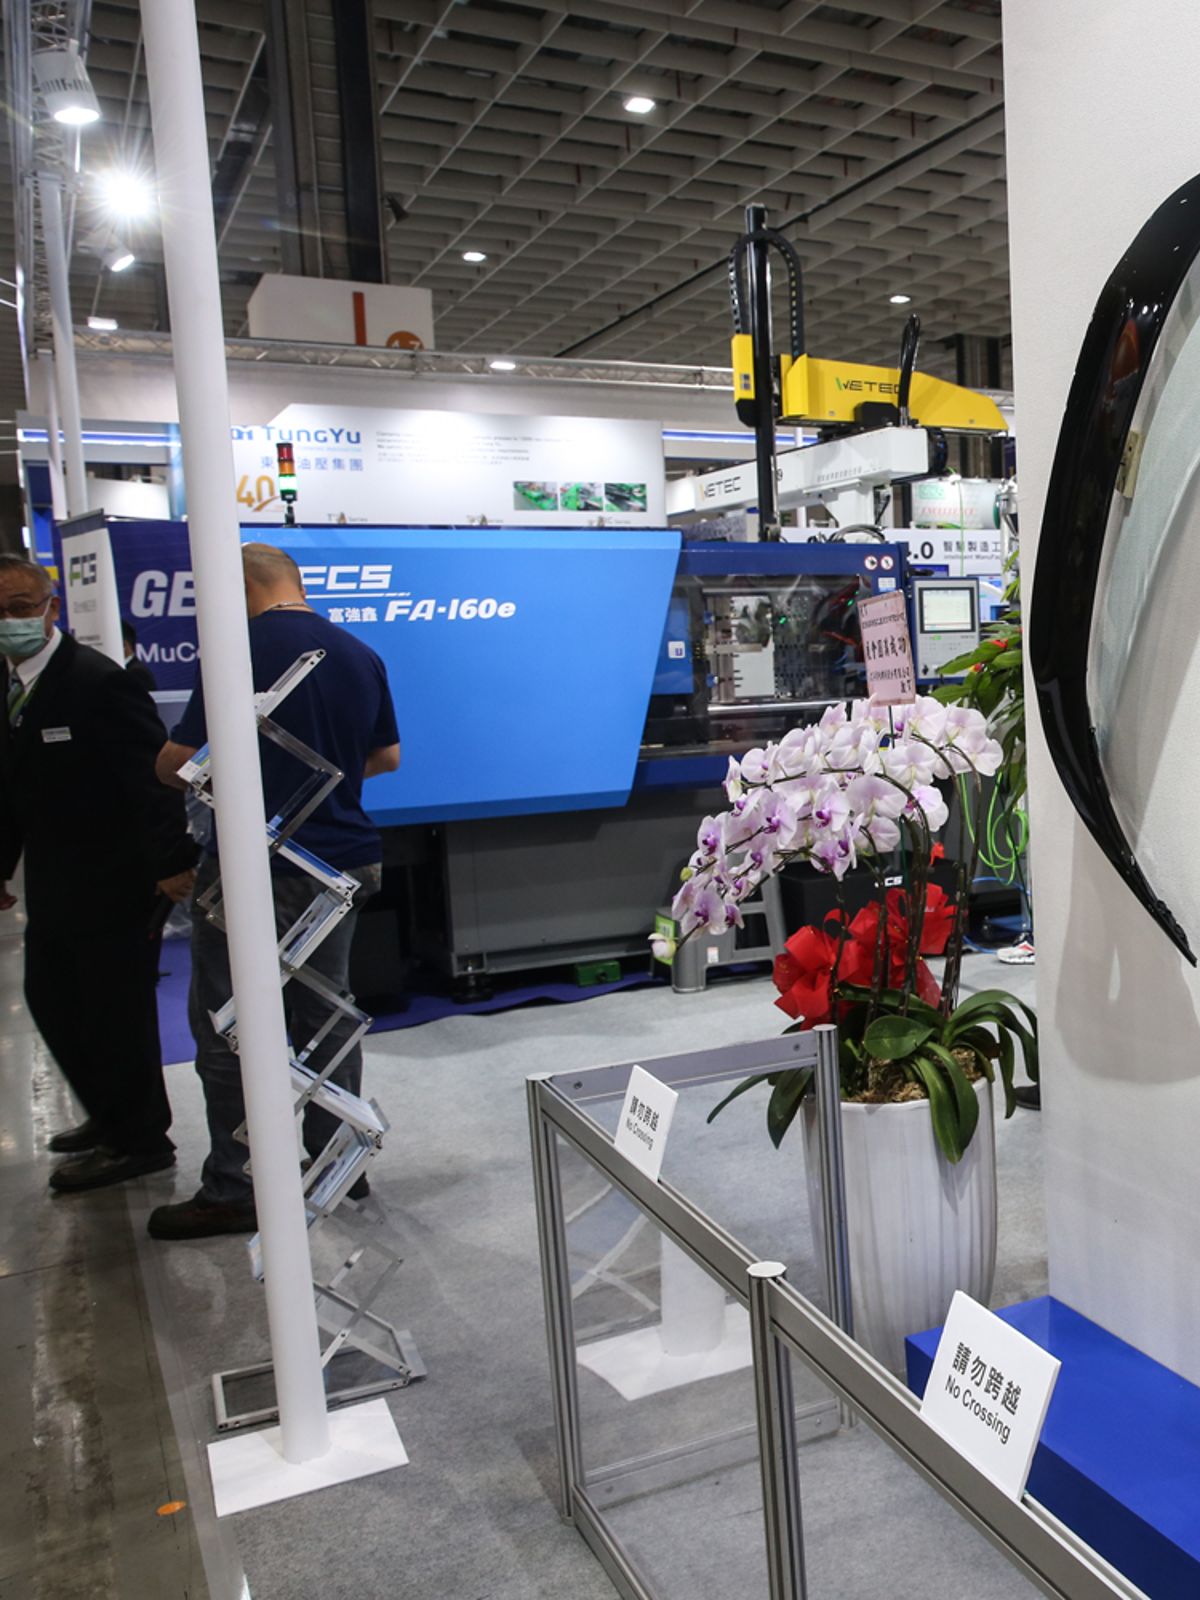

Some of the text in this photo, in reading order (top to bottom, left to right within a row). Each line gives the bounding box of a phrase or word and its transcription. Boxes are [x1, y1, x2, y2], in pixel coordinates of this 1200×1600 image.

[907, 541, 934, 560] .0
[299, 564, 393, 590] FCS
[328, 598, 517, 623] 富強鑫 FA-160e
[135, 641, 201, 663] MuC
[951, 1341, 1022, 1416] 請勿跨越
[945, 1375, 1011, 1445] No Crossing
